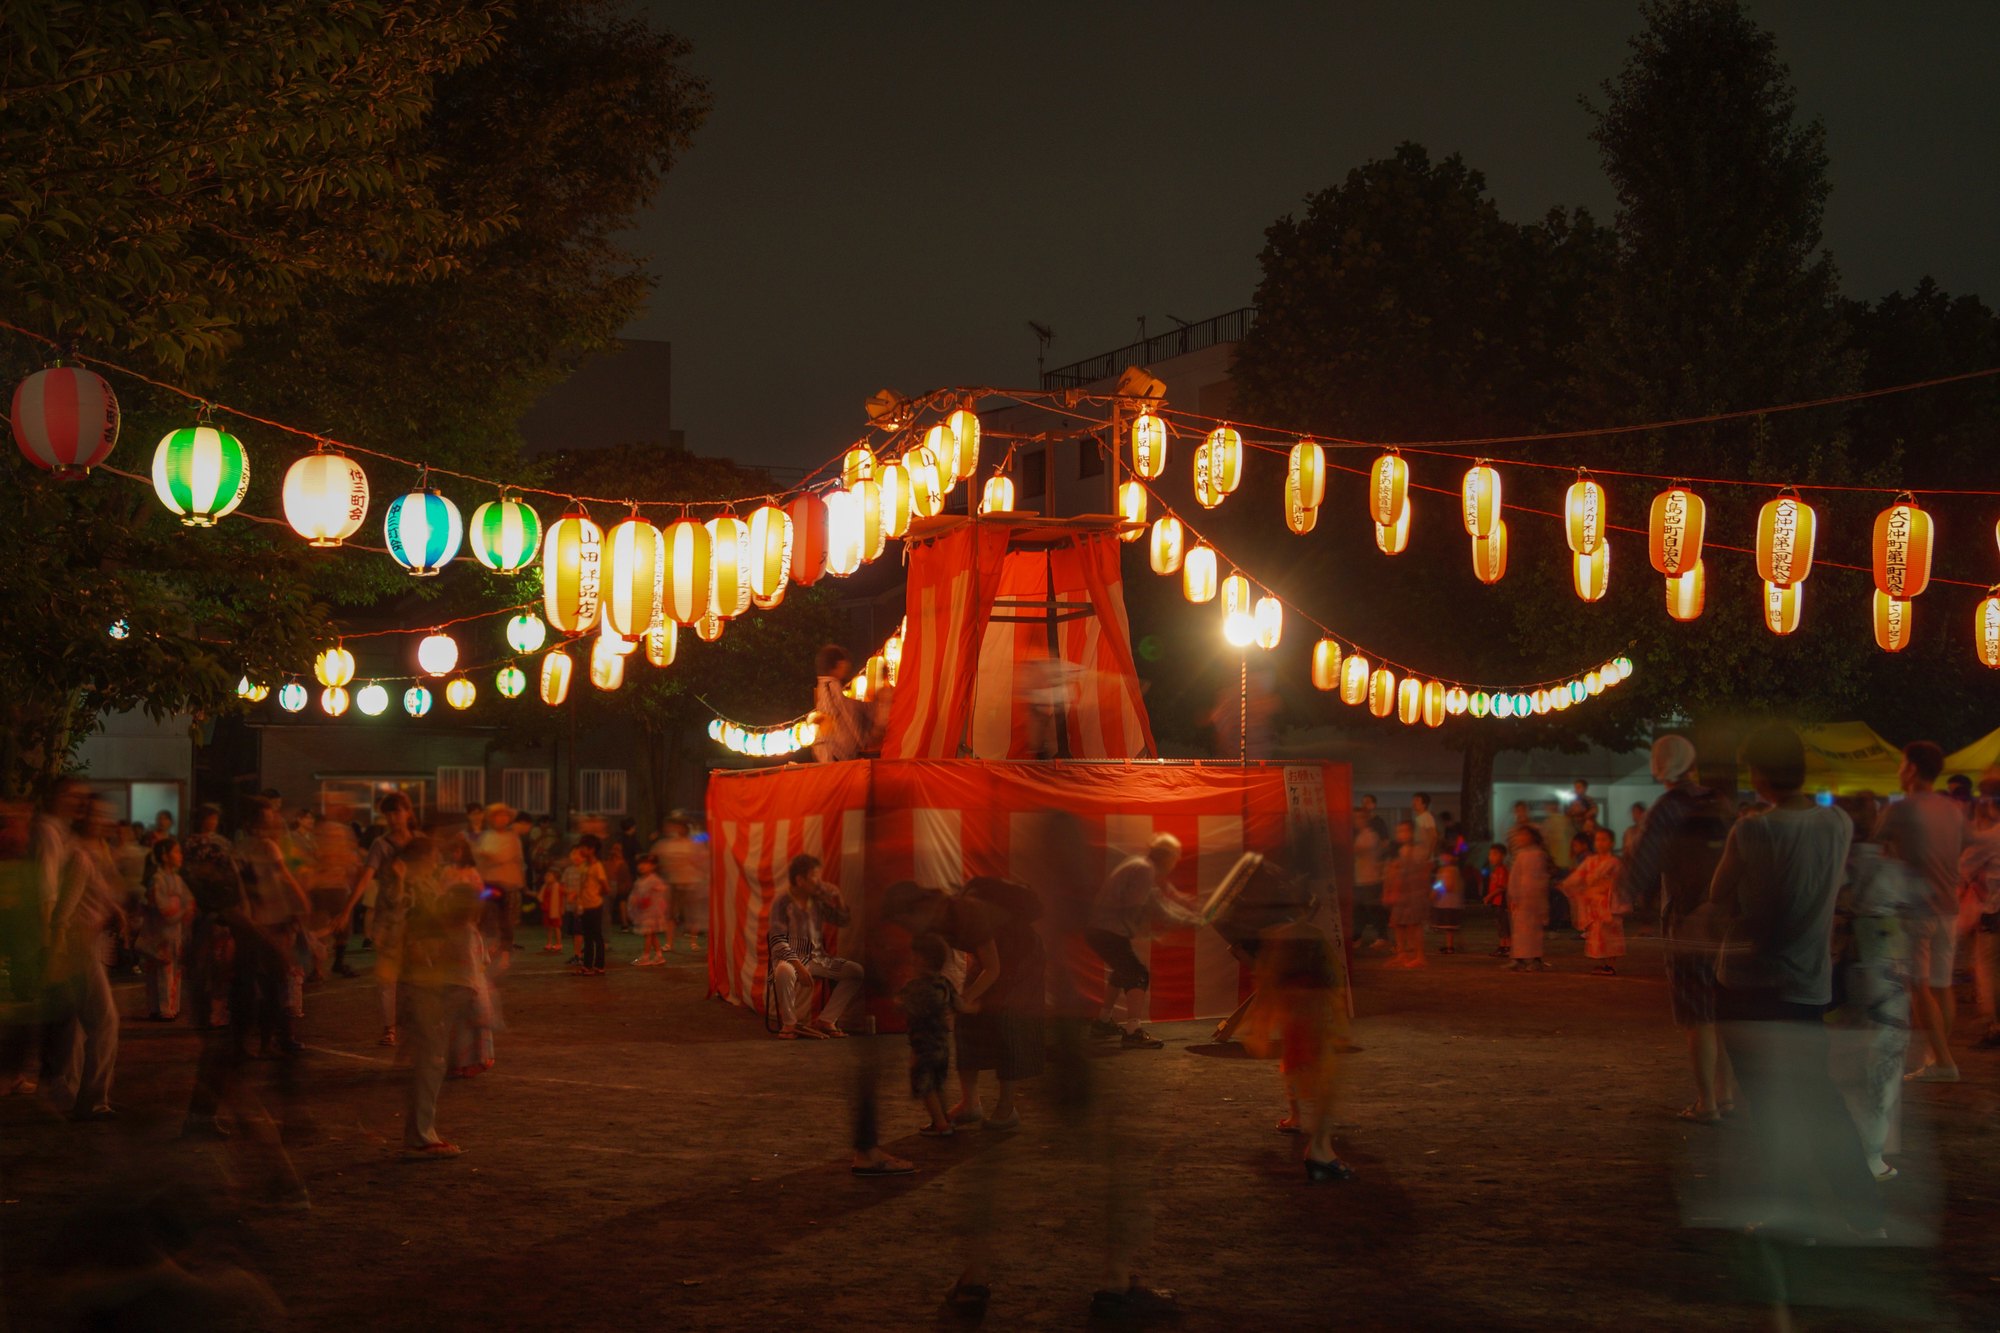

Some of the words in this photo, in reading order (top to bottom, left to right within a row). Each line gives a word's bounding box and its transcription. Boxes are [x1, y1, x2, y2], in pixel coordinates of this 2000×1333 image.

[1662, 494, 1686, 569] 七島西町自治会
[1886, 510, 1908, 593] 大口仲町第一町内会
